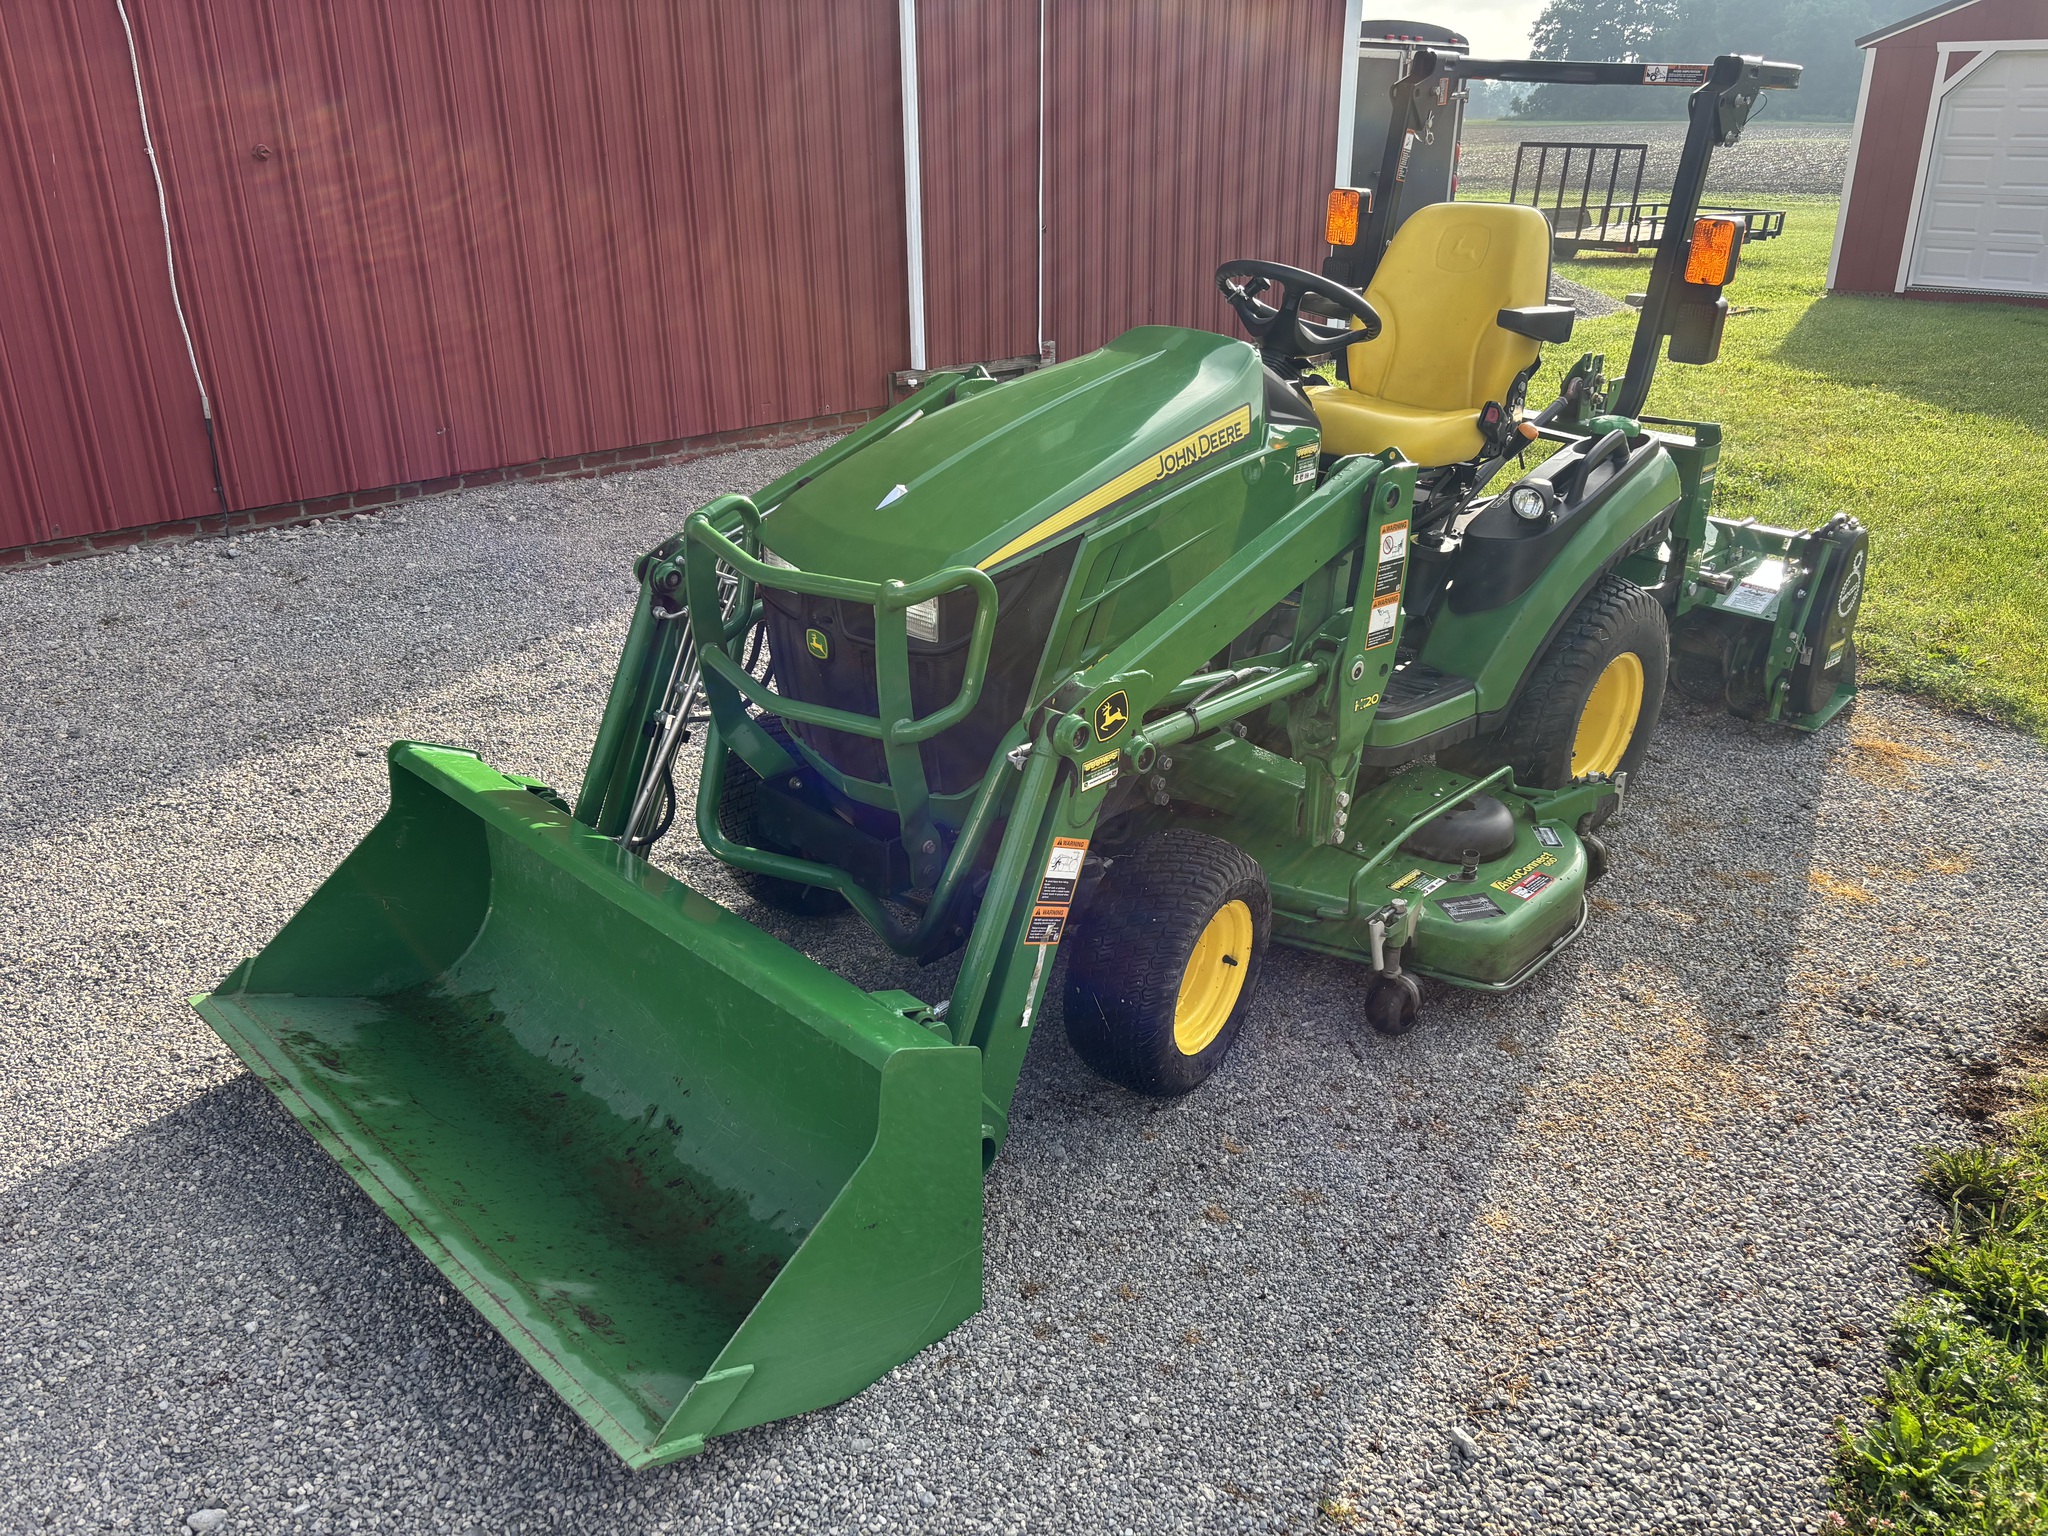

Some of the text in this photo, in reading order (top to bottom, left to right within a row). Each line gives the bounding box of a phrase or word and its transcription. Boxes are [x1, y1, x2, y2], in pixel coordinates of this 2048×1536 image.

[1156, 421, 1243, 478] JOHN DEERE
[1386, 521, 1407, 533] WARNING
[1377, 594, 1399, 606] WARNING
[1496, 851, 1554, 891] AutoConnect
